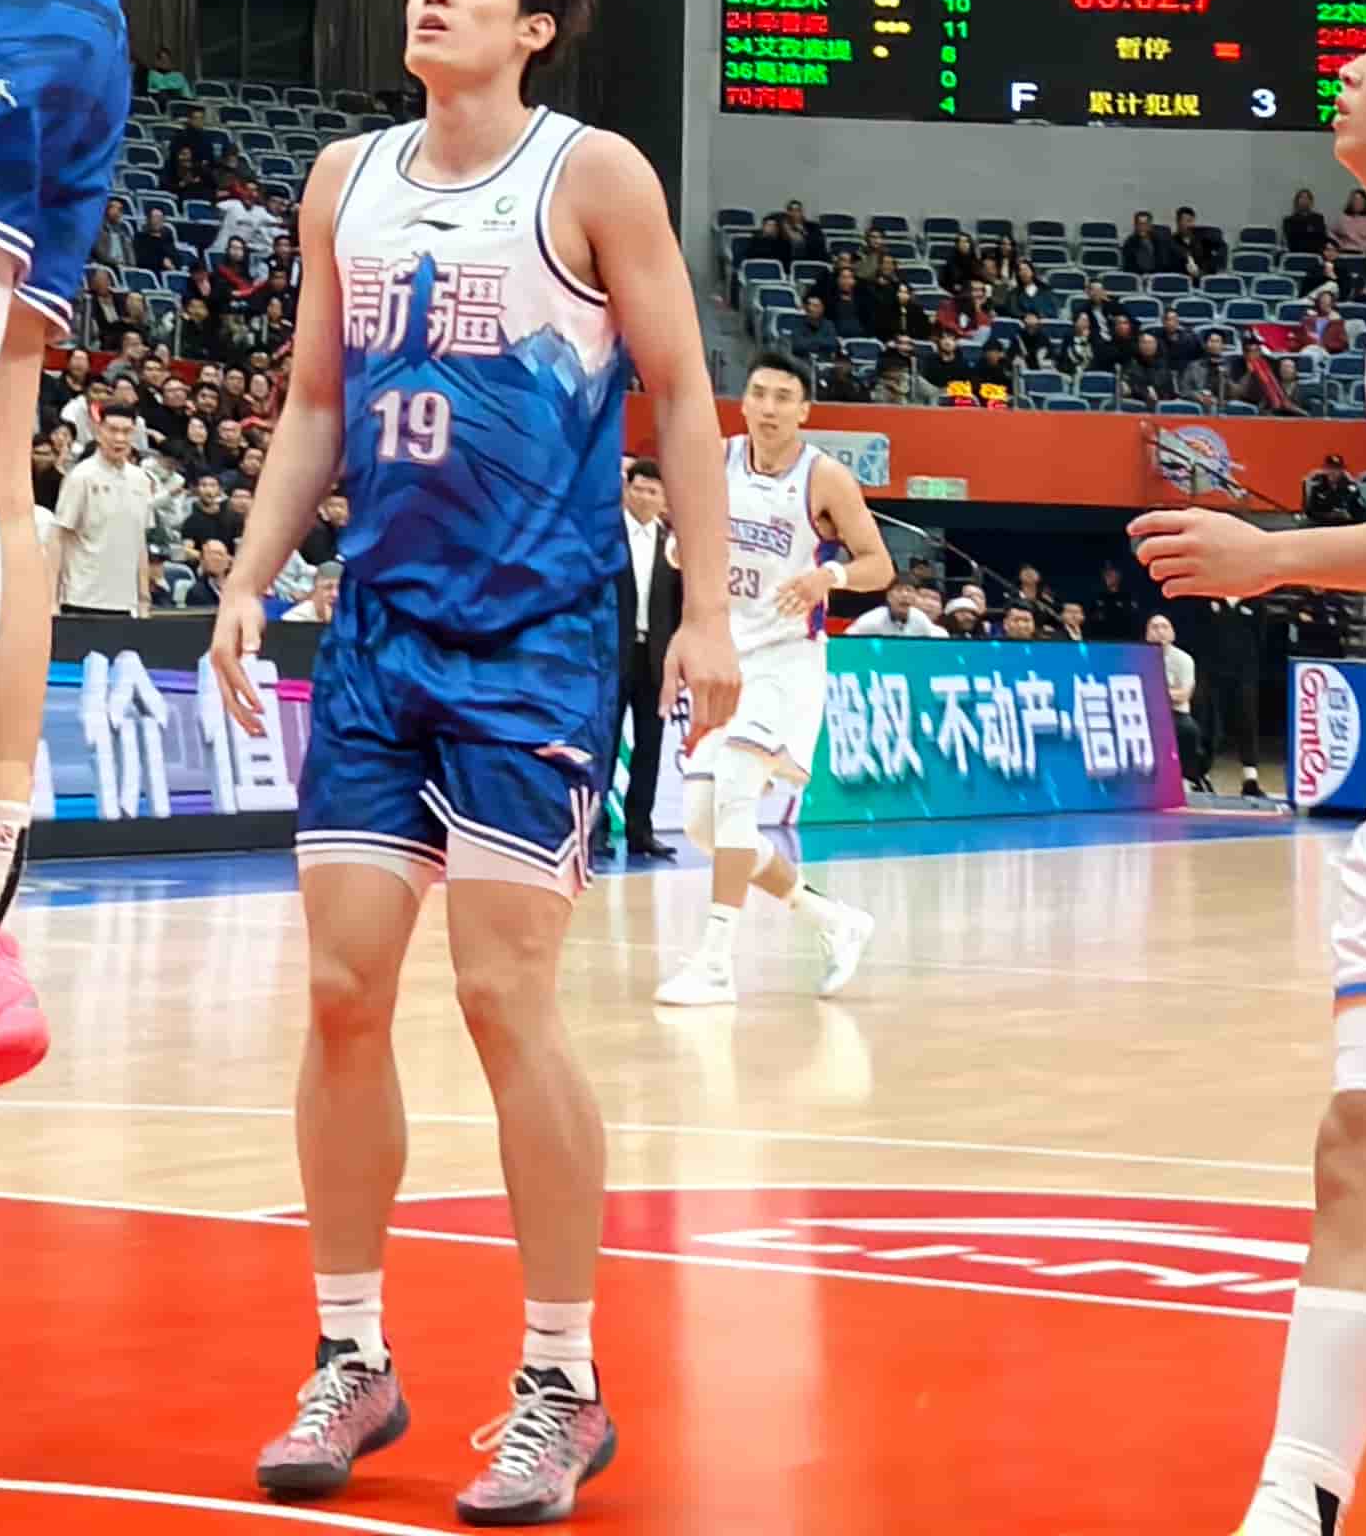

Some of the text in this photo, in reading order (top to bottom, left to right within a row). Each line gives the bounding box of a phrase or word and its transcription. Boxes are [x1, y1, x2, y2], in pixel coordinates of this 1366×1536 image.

[943, 20, 969, 38] 11
[1116, 36, 1172, 60] 暂停
[940, 70, 957, 88] 0
[939, 96, 956, 115] 4
[1010, 82, 1278, 118] F 累计犯规 3
[370, 389, 451, 463] 19
